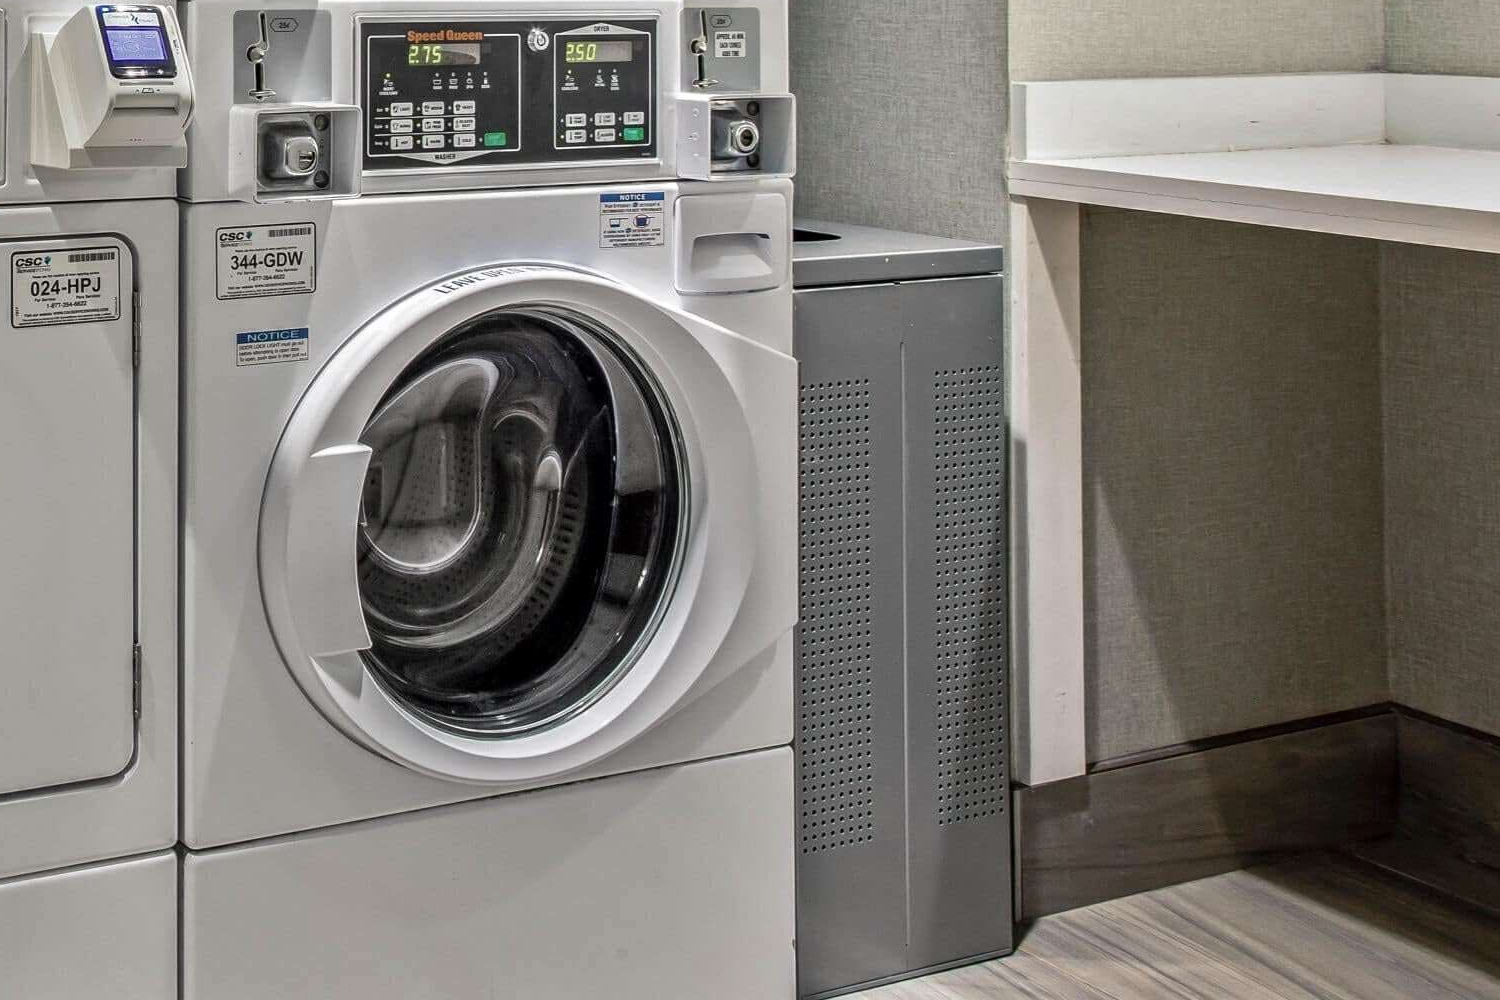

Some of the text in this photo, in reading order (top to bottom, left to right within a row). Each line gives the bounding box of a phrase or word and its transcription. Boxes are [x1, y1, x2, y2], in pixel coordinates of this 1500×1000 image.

[408, 30, 484, 43] Speed Queen
[408, 46, 442, 64] 2.75
[220, 232, 244, 242] CSC
[16, 257, 42, 267] CSC
[231, 251, 303, 270] 344-GDW
[31, 277, 100, 296] 024-HPJ
[433, 276, 486, 294] LEAVE
[248, 330, 299, 342] NOTICE
